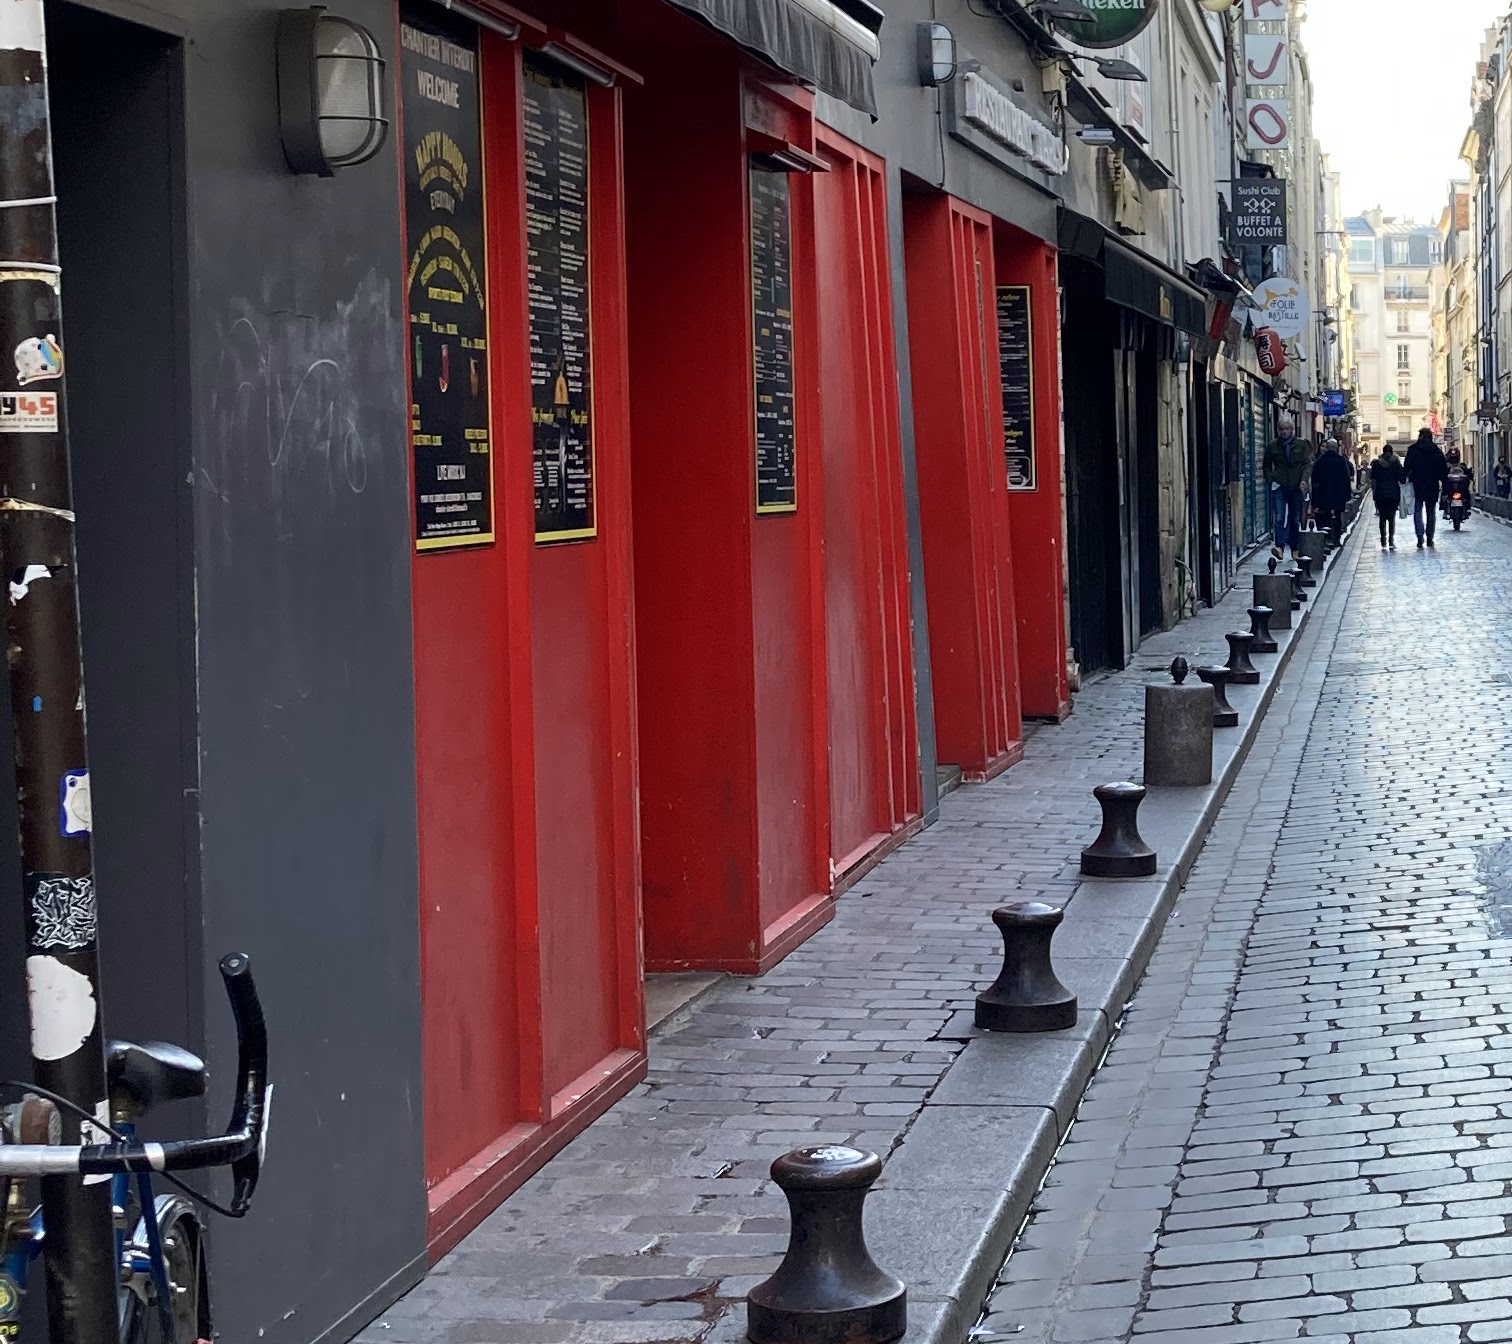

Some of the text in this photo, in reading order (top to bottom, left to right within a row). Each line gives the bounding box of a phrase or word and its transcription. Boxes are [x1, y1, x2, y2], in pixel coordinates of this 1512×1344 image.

[417, 68, 460, 109] WELCOME
[1237, 186, 1281, 196] Sushi Club
[1237, 216, 1283, 226] BUFFET A
[1236, 227, 1284, 237] VOLONTE
